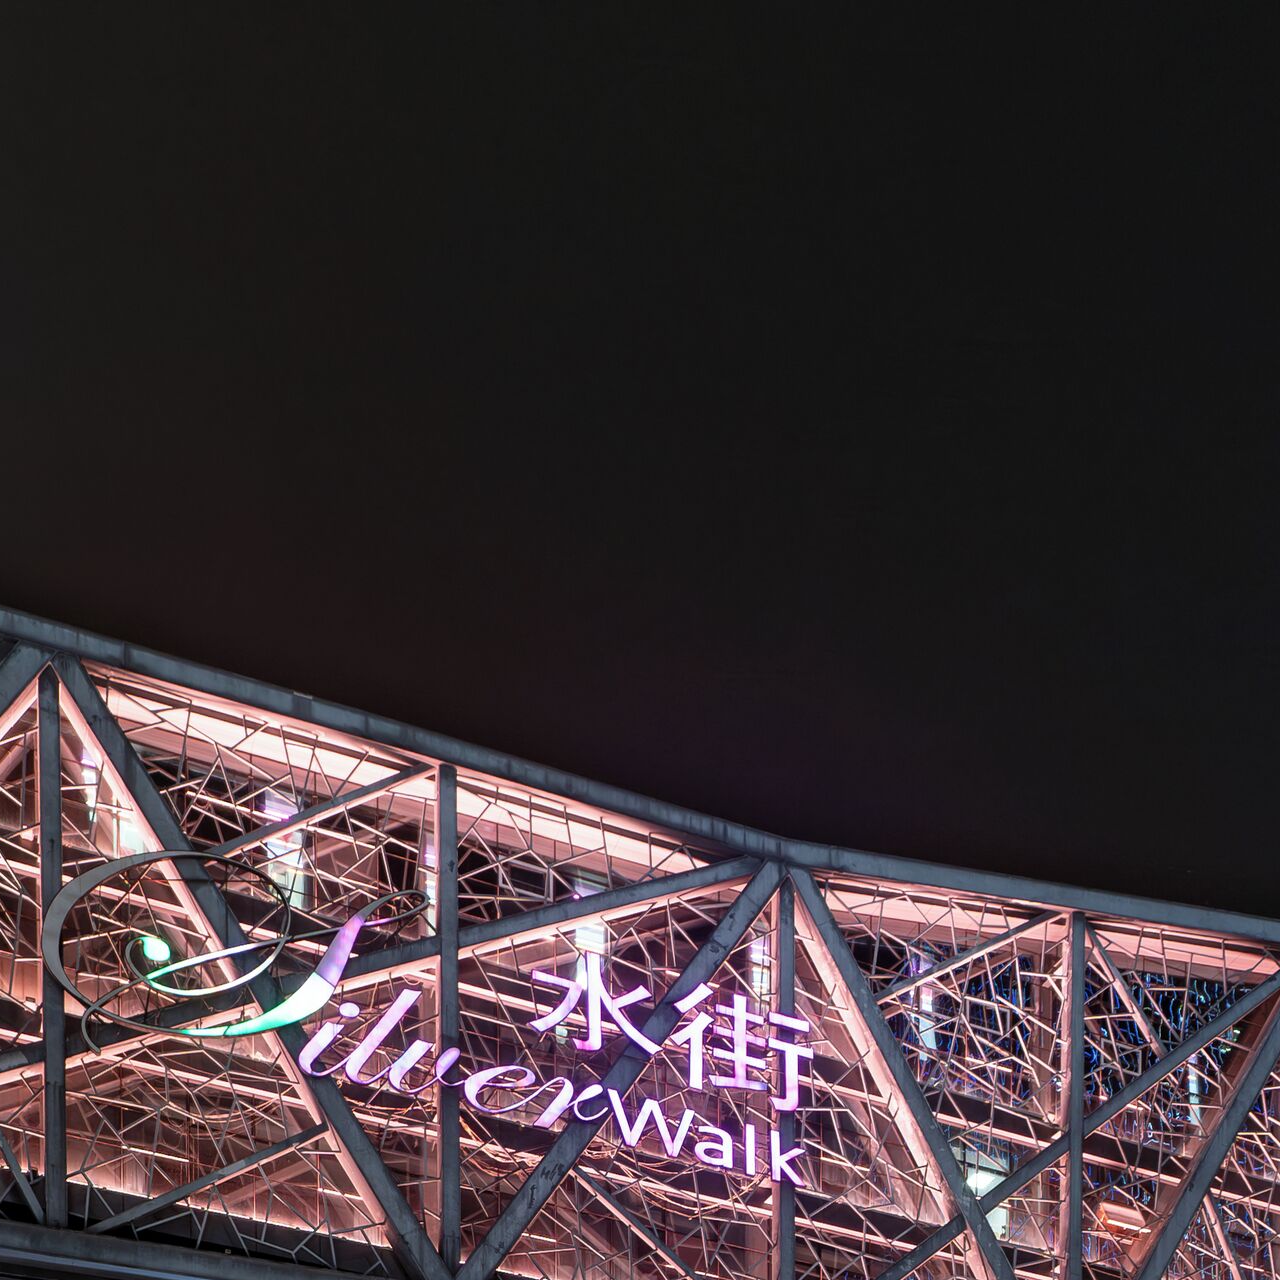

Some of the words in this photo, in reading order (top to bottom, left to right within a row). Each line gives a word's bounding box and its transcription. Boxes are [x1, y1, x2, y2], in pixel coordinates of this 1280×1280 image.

[41, 849, 610, 1128] Silver
[609, 1087, 806, 1187] Walk
[529, 950, 815, 1113] 水街
